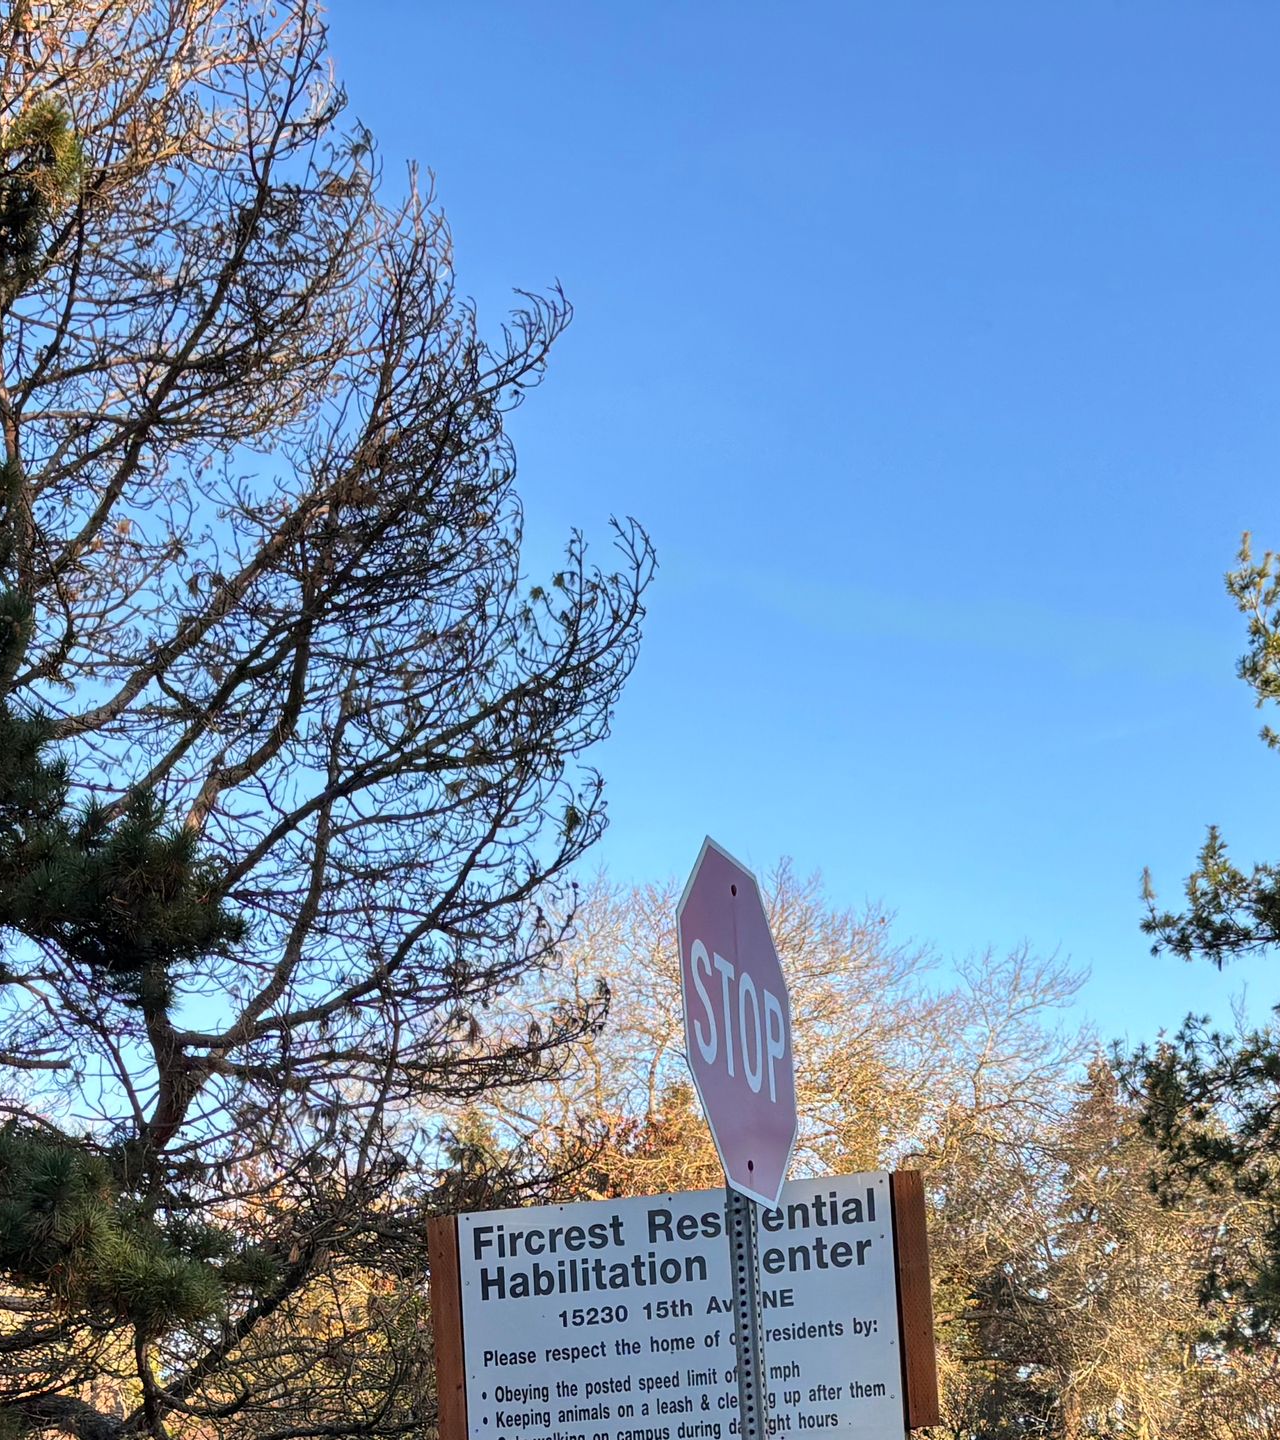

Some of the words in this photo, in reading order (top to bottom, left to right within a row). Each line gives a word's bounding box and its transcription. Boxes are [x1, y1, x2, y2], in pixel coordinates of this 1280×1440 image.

[690, 938, 785, 1103] STOP
[473, 1214, 625, 1260] Fircrest
[647, 1188, 876, 1244] Resiential
[480, 1252, 708, 1301] Habilitation
[762, 1237, 872, 1275] enter
[558, 1305, 629, 1329] 15230
[642, 1299, 693, 1320] 15th
[706, 1296, 735, 1315] Av
[763, 1288, 795, 1309] NE
[483, 1349, 536, 1368] Please
[545, 1341, 606, 1363] respect
[615, 1338, 641, 1356] the
[650, 1334, 695, 1352] home
[704, 1330, 720, 1348] of
[765, 1320, 844, 1342] residents
[852, 1317, 878, 1337] by:
[495, 1384, 549, 1404] Obeying
[556, 1380, 578, 1398] the
[585, 1375, 631, 1399] posted
[638, 1371, 679, 1393] speed
[687, 1368, 717, 1387] limit
[770, 1360, 800, 1382] mph
[496, 1409, 551, 1430] Keeping
[558, 1403, 610, 1423] animals
[617, 1403, 634, 1418] on
[641, 1403, 649, 1416] a
[656, 1396, 693, 1415] leash
[700, 1394, 710, 1411] &
[783, 1390, 801, 1407] up
[808, 1384, 842, 1402] after
[849, 1381, 886, 1398] them
[677, 1420, 721, 1440] during
[798, 1412, 839, 1429] hours
